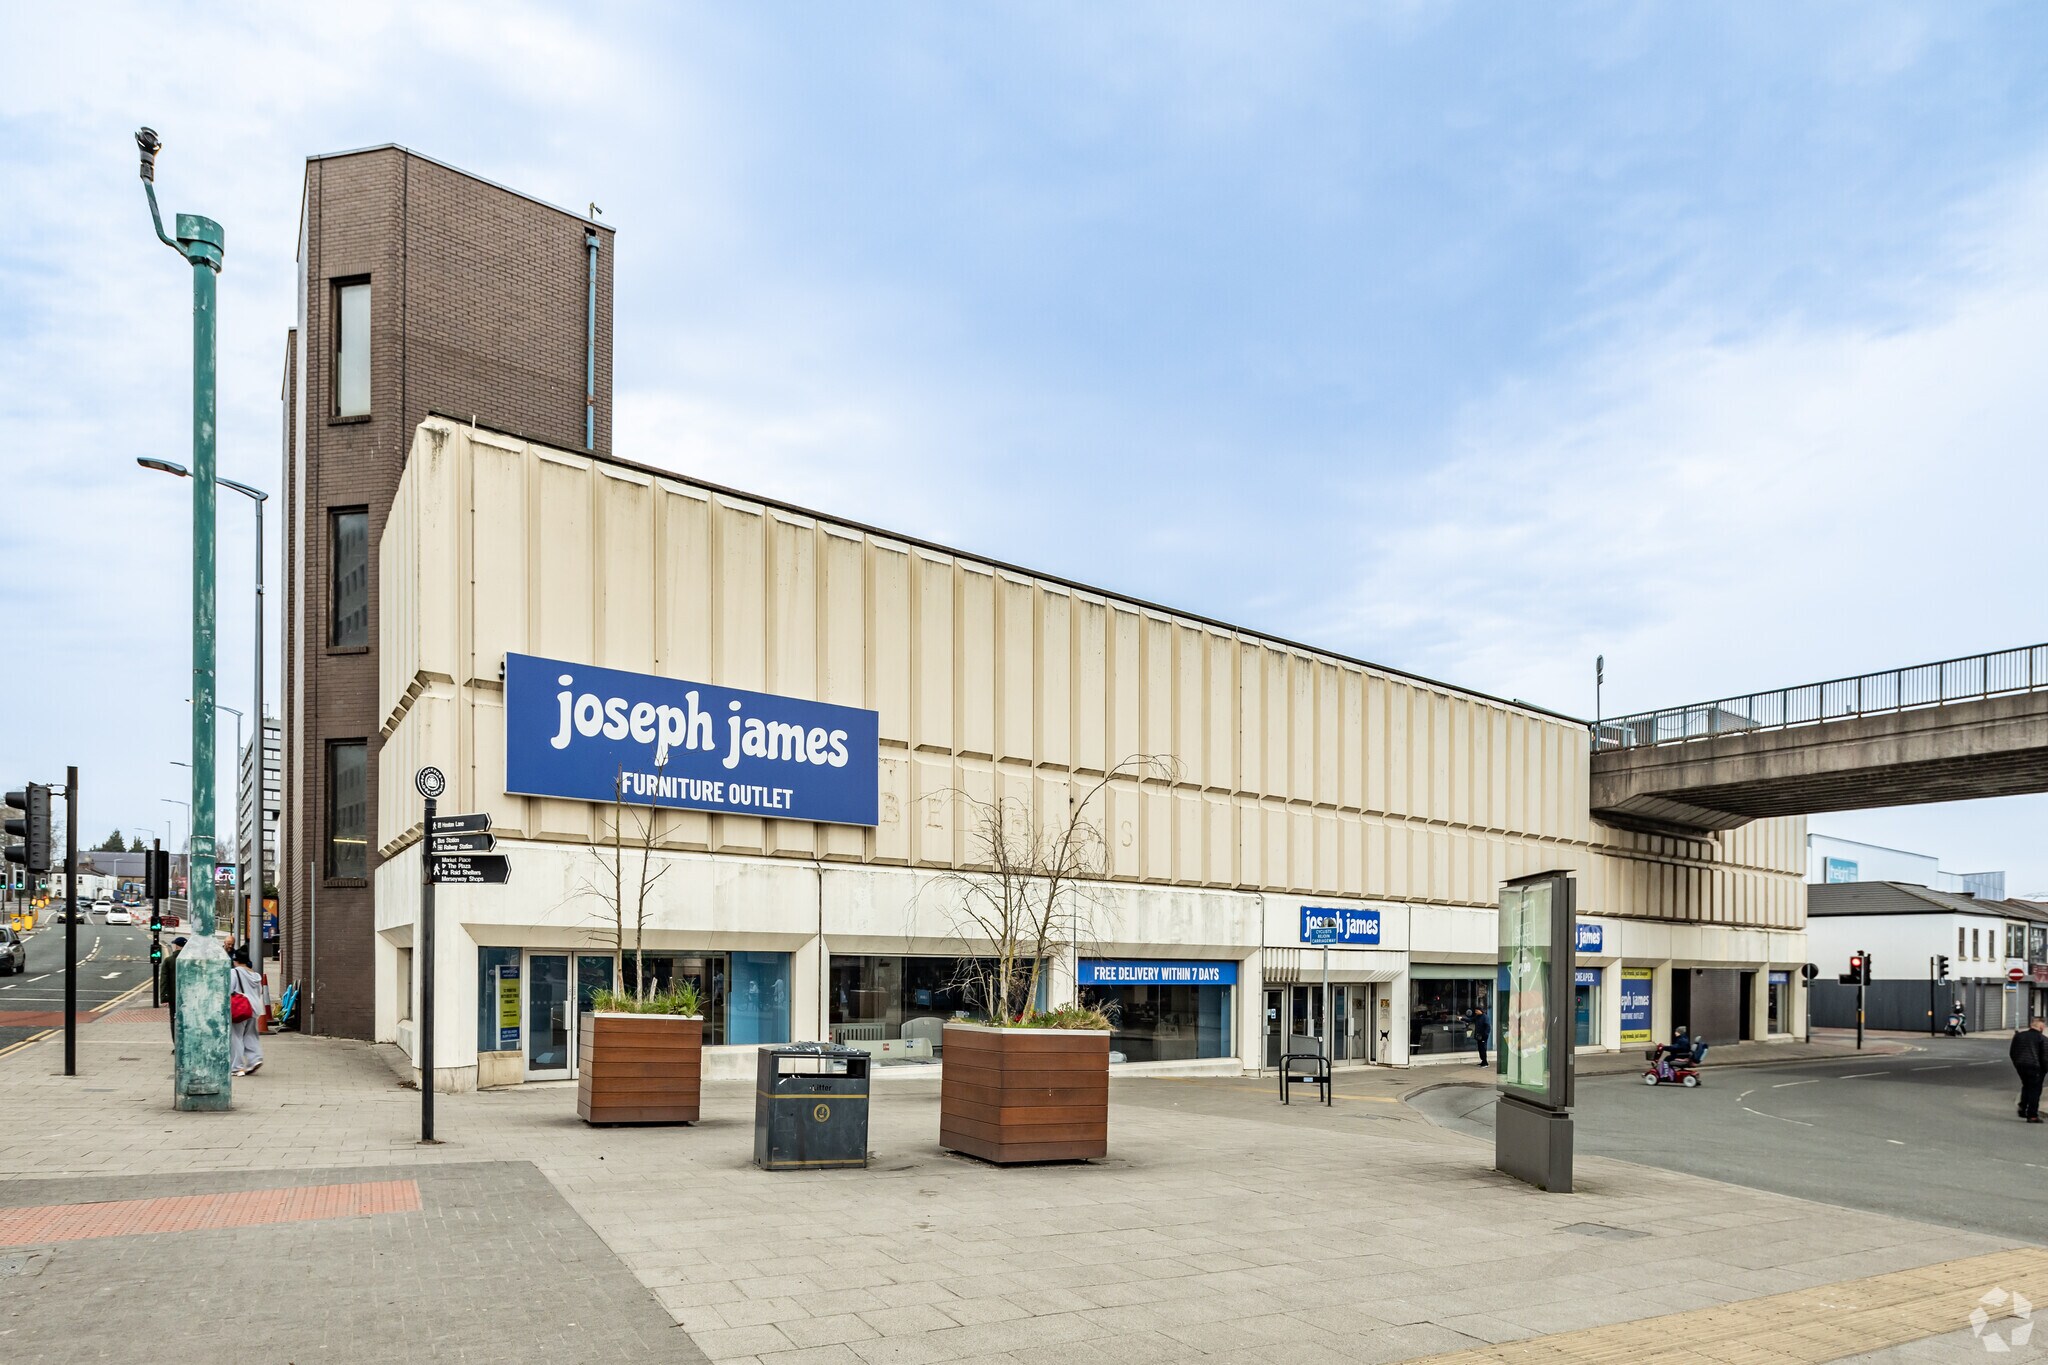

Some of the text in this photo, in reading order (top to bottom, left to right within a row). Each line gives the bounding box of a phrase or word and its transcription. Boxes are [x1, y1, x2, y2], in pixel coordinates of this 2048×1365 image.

[550, 674, 849, 770] joseph james
[621, 771, 794, 811] FURNITURE OUTLET
[1304, 910, 1378, 940] josh james
[1579, 927, 1600, 948] james
[1094, 966, 1220, 981] FREE DELIVERY WITHIN 7 DAYS
[1632, 992, 1649, 1010] james
[812, 1084, 832, 1092] Litter
